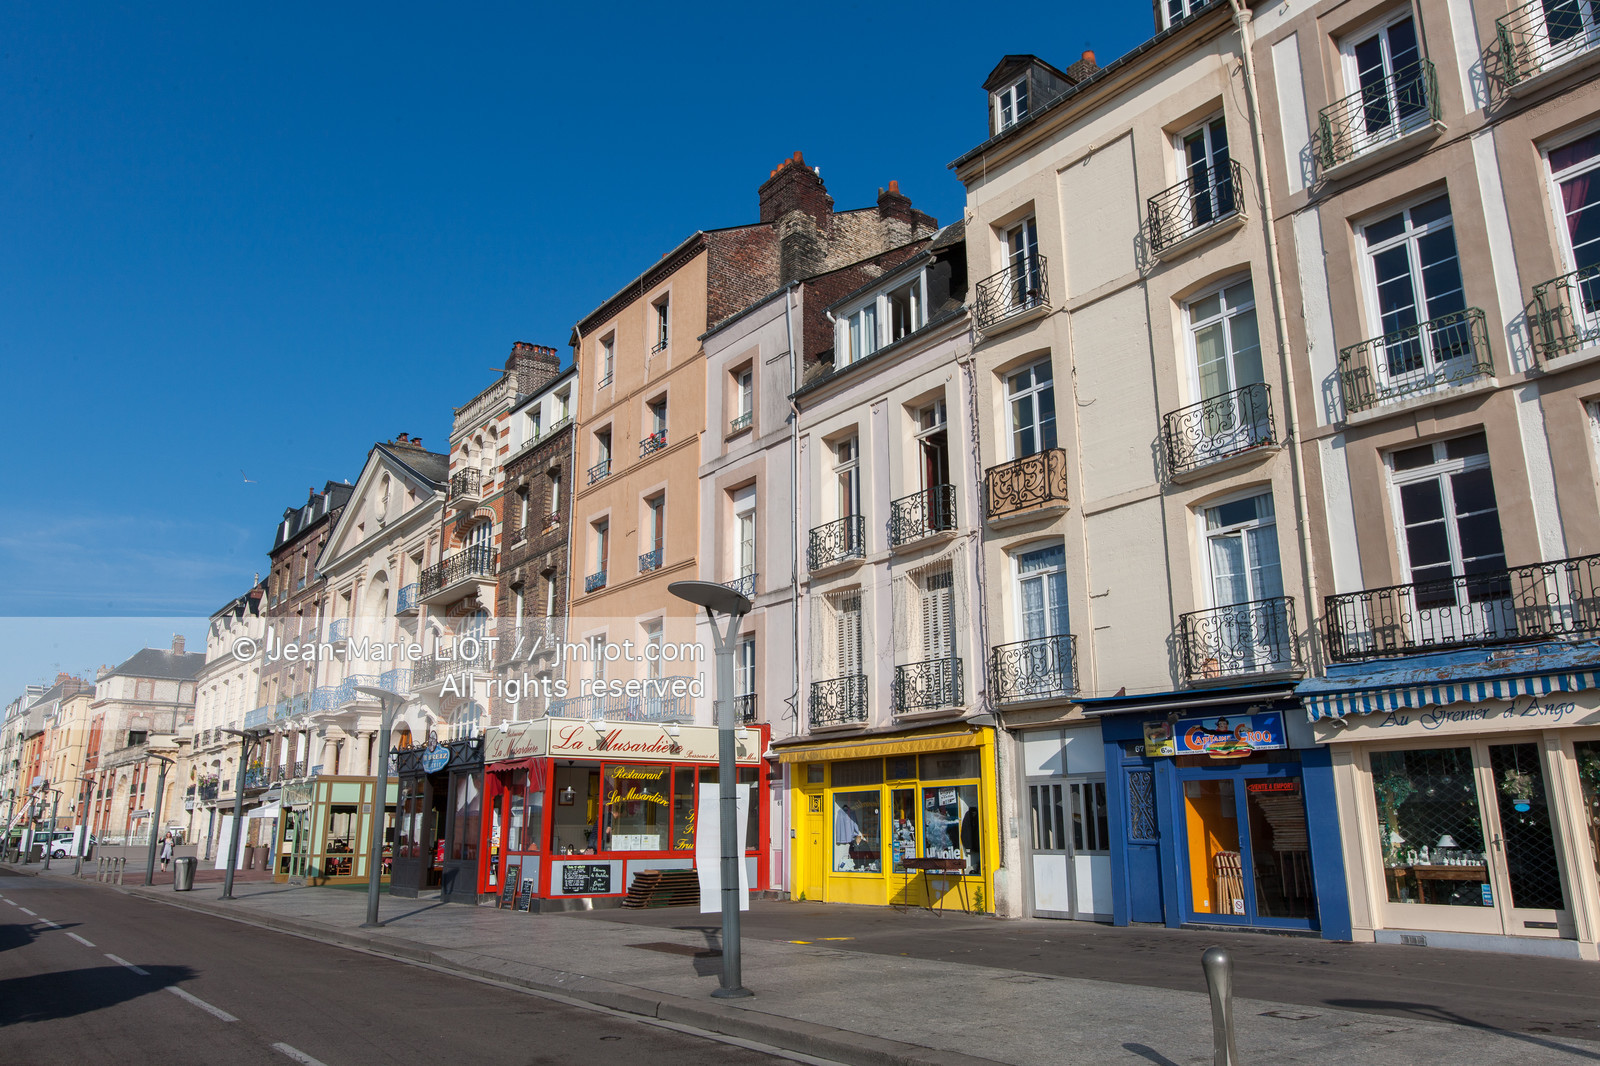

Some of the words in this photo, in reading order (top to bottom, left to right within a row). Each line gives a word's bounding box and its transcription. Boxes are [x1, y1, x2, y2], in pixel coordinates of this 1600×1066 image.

[1379, 711, 1409, 727] Au
[1420, 706, 1490, 730] Grenier
[1503, 698, 1576, 722] d'Ango
[551, 725, 585, 750] La
[588, 728, 684, 754] Musardière
[1234, 723, 1272, 743] CROQ
[611, 765, 663, 781] Restaurant
[605, 790, 621, 807] La
[622, 786, 670, 807] Musardière
